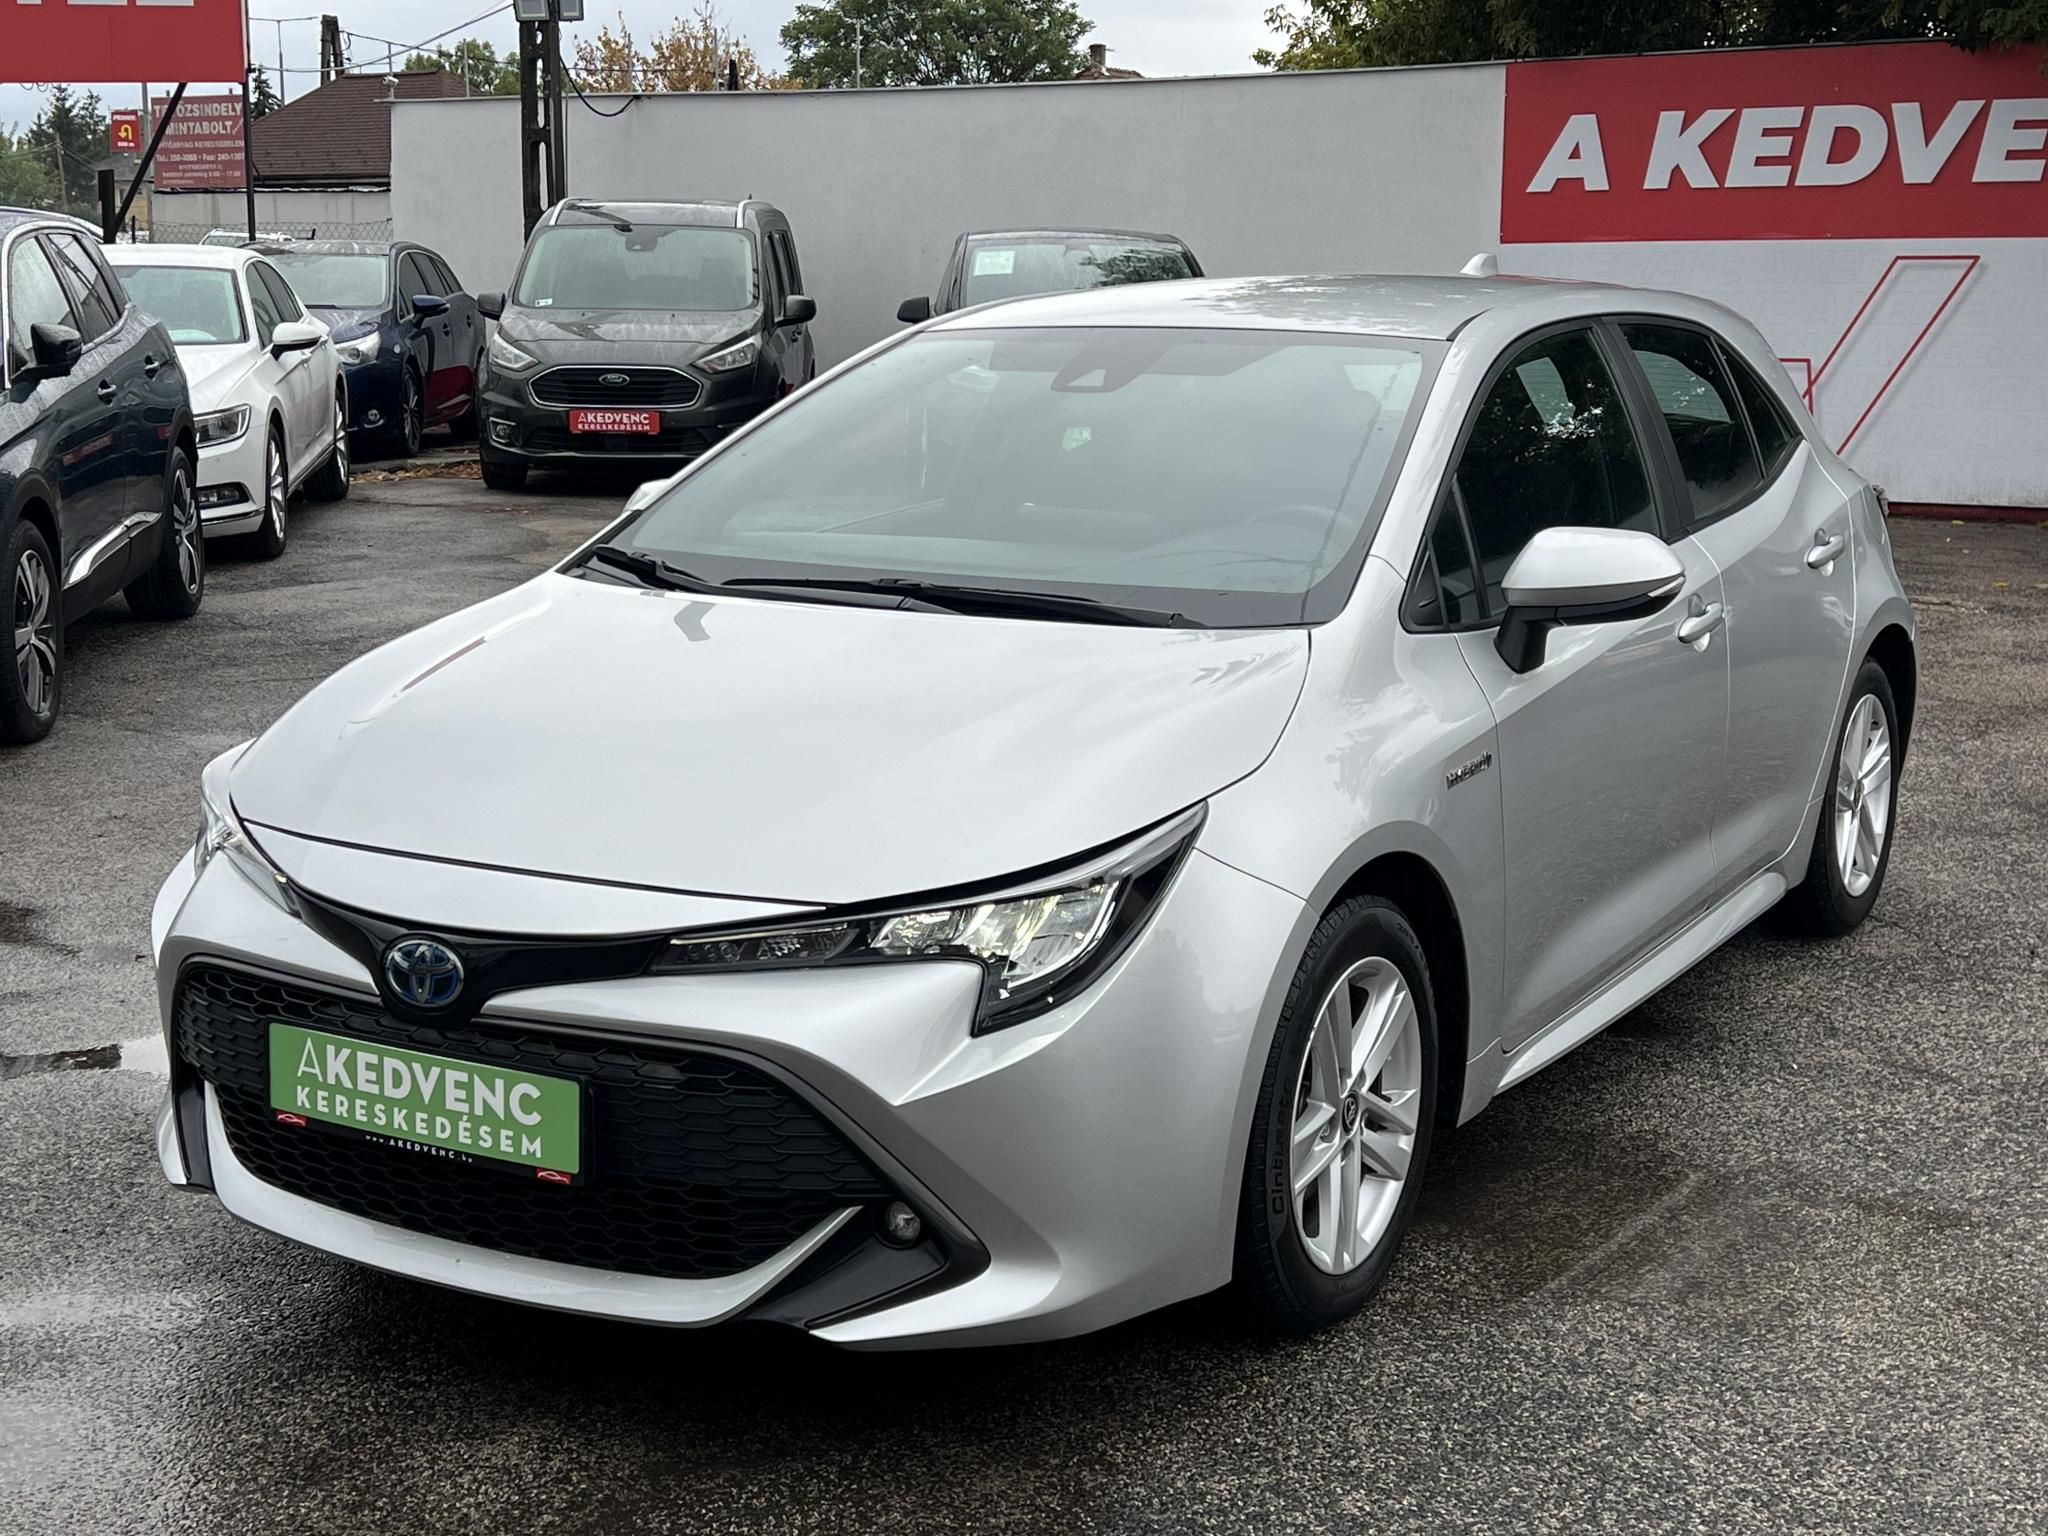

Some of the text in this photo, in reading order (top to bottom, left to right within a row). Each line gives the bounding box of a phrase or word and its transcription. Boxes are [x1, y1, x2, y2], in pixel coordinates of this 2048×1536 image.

[1526, 97, 2048, 193] A KEDVE
[296, 1084, 543, 1159] KERESKEDÉSEM
